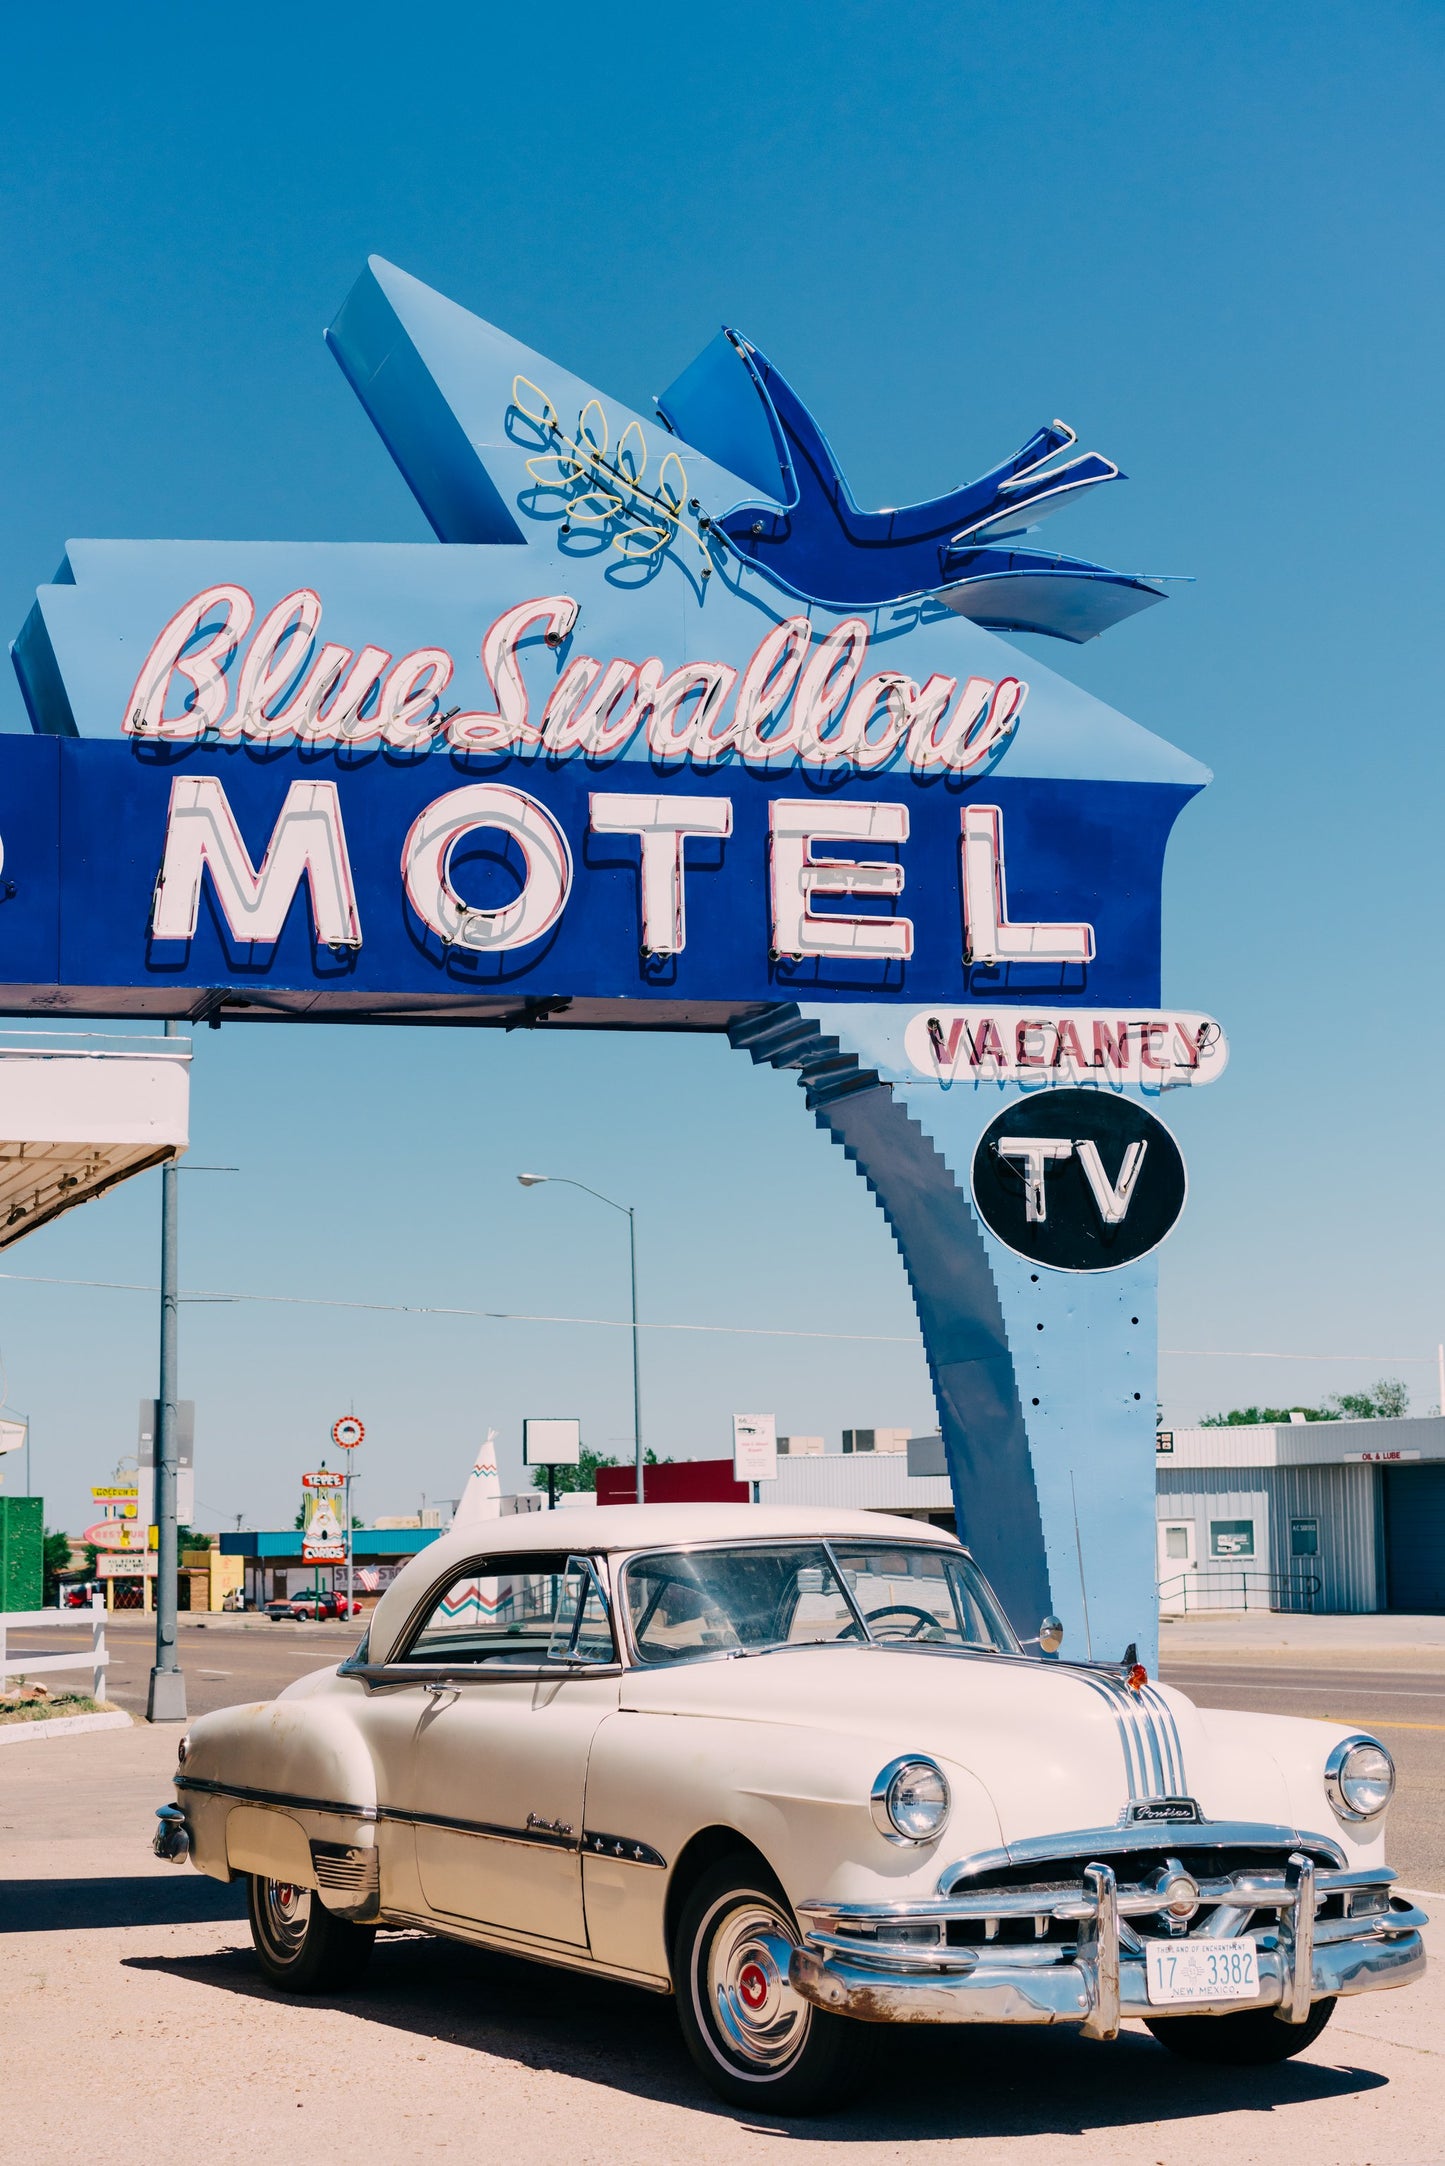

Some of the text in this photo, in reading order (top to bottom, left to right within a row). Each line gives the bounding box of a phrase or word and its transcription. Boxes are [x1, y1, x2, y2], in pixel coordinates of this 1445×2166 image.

[121, 583, 1029, 772] Blue Swallow
[151, 774, 1096, 965] MOTEL
[927, 1017, 1213, 1070] VACANCY
[997, 1136, 1148, 1223] TV
[1362, 1451, 1401, 1461] OIL & LUBE
[304, 1546, 345, 1560] CURIOS
[1136, 1805, 1191, 1820] Pontiac
[1157, 1953, 1254, 1989] 17 3382
[1199, 1986, 1235, 1995] MEXICO
